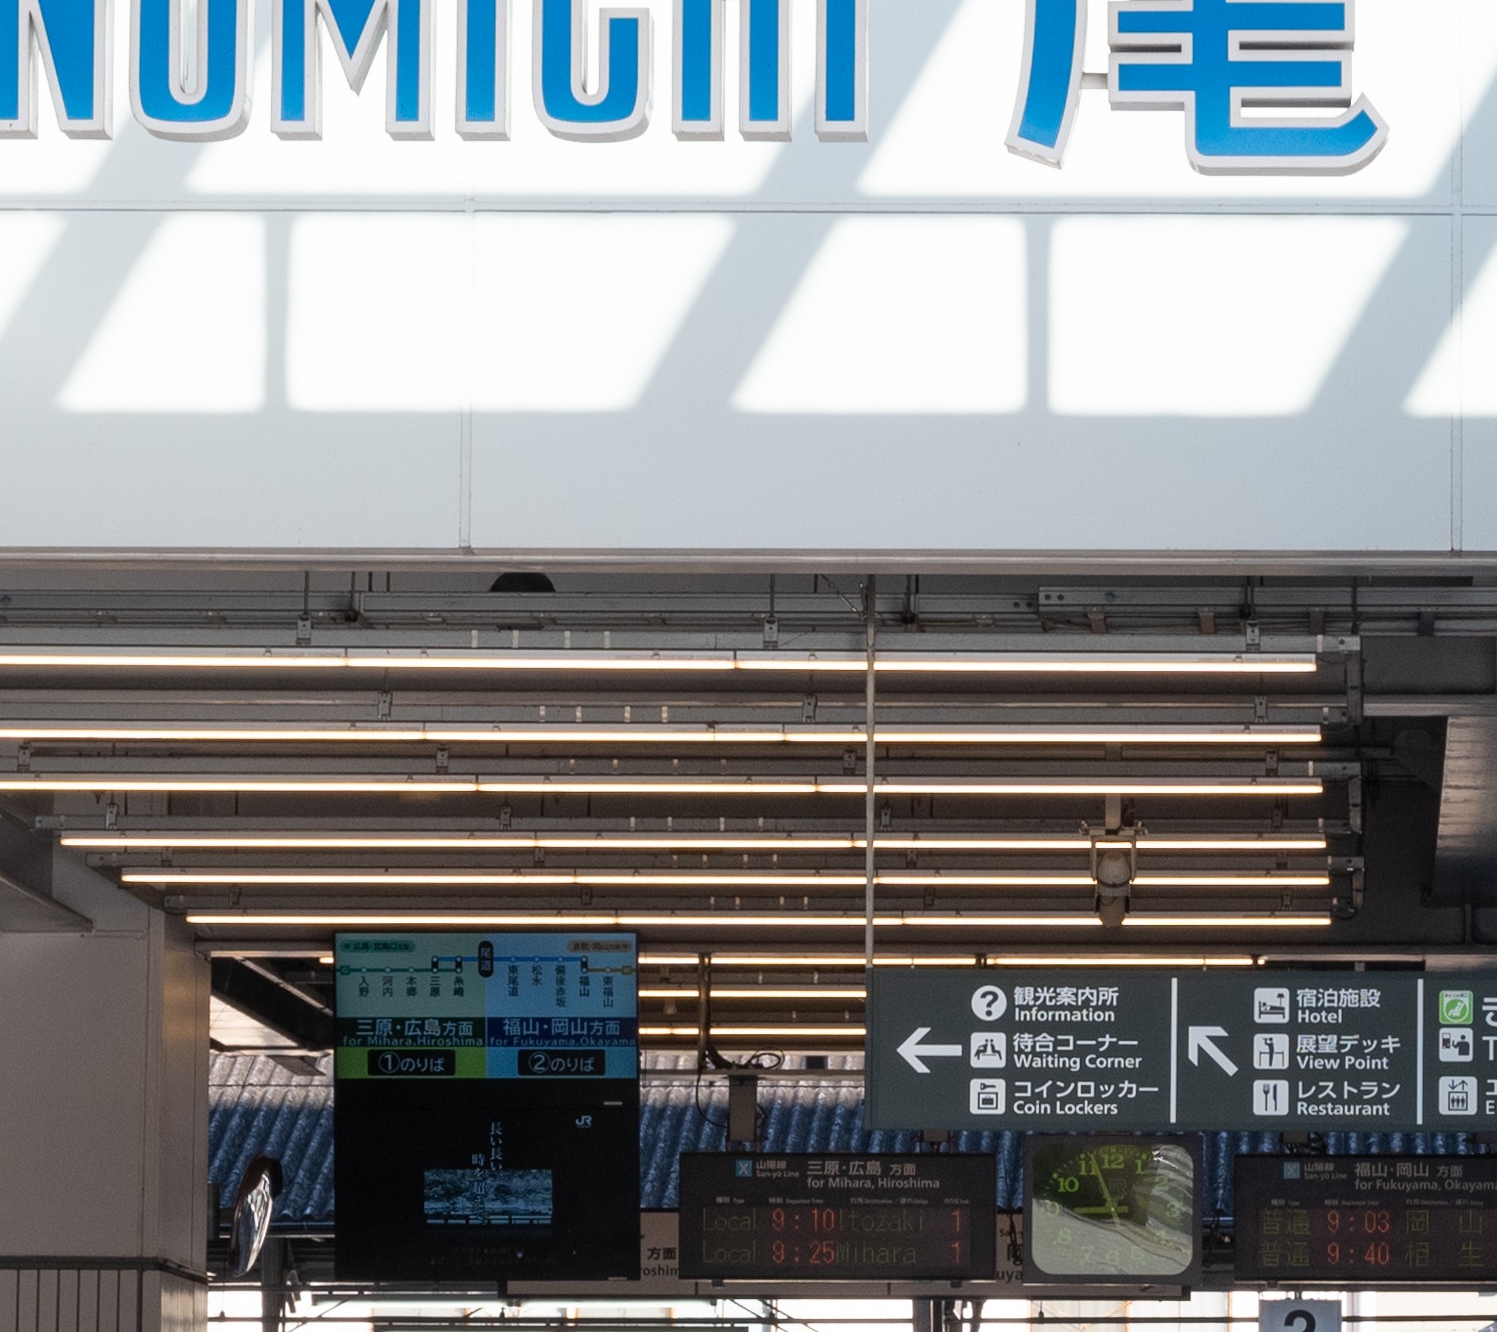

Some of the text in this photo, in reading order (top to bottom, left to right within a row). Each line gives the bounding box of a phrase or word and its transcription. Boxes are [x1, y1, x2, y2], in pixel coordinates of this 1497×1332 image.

[429, 976, 441, 998] 三原
[578, 976, 591, 998] 福山
[1014, 986, 1119, 1007] 観光案内所
[1297, 988, 1381, 1009] 宿泊施設
[1014, 1007, 1116, 1023] Information
[1297, 1008, 1343, 1024] Hotel
[356, 1018, 473, 1036] 三原・広島方面
[502, 1018, 620, 1036] 福山・岡山方面
[1013, 1033, 1139, 1053] 待合コーナー
[1296, 1034, 1401, 1055] 展望デッキ
[1014, 1053, 1143, 1071] Waiting Corner
[1296, 1055, 1390, 1070] View Point
[1013, 1079, 1159, 1099] コインロッカー
[1297, 1080, 1401, 1100] レストラン
[1013, 1099, 1119, 1115] Coin Lockers
[1297, 1100, 1390, 1117] Restaurant
[806, 1160, 917, 1176] 三原・広島 方面
[1102, 1153, 1125, 1169] 12
[1354, 1162, 1463, 1178] 福山・岡山 方面
[807, 1177, 940, 1190] for Mihara, Hiroshima
[1057, 1176, 1080, 1193] 10
[1354, 1178, 1374, 1191] for
[1375, 1178, 1442, 1193] Fukuyama,
[771, 1208, 836, 1233] 9:10
[951, 1209, 962, 1233] 1
[1259, 1209, 1311, 1235] 普通
[1327, 1210, 1390, 1234] 9:03
[646, 1247, 677, 1261] 方面
[771, 1240, 836, 1265] 9:25
[835, 1240, 918, 1264] Mihara
[951, 1241, 962, 1265] 1
[1258, 1241, 1311, 1267] 普通
[1327, 1242, 1390, 1266] 9:40
